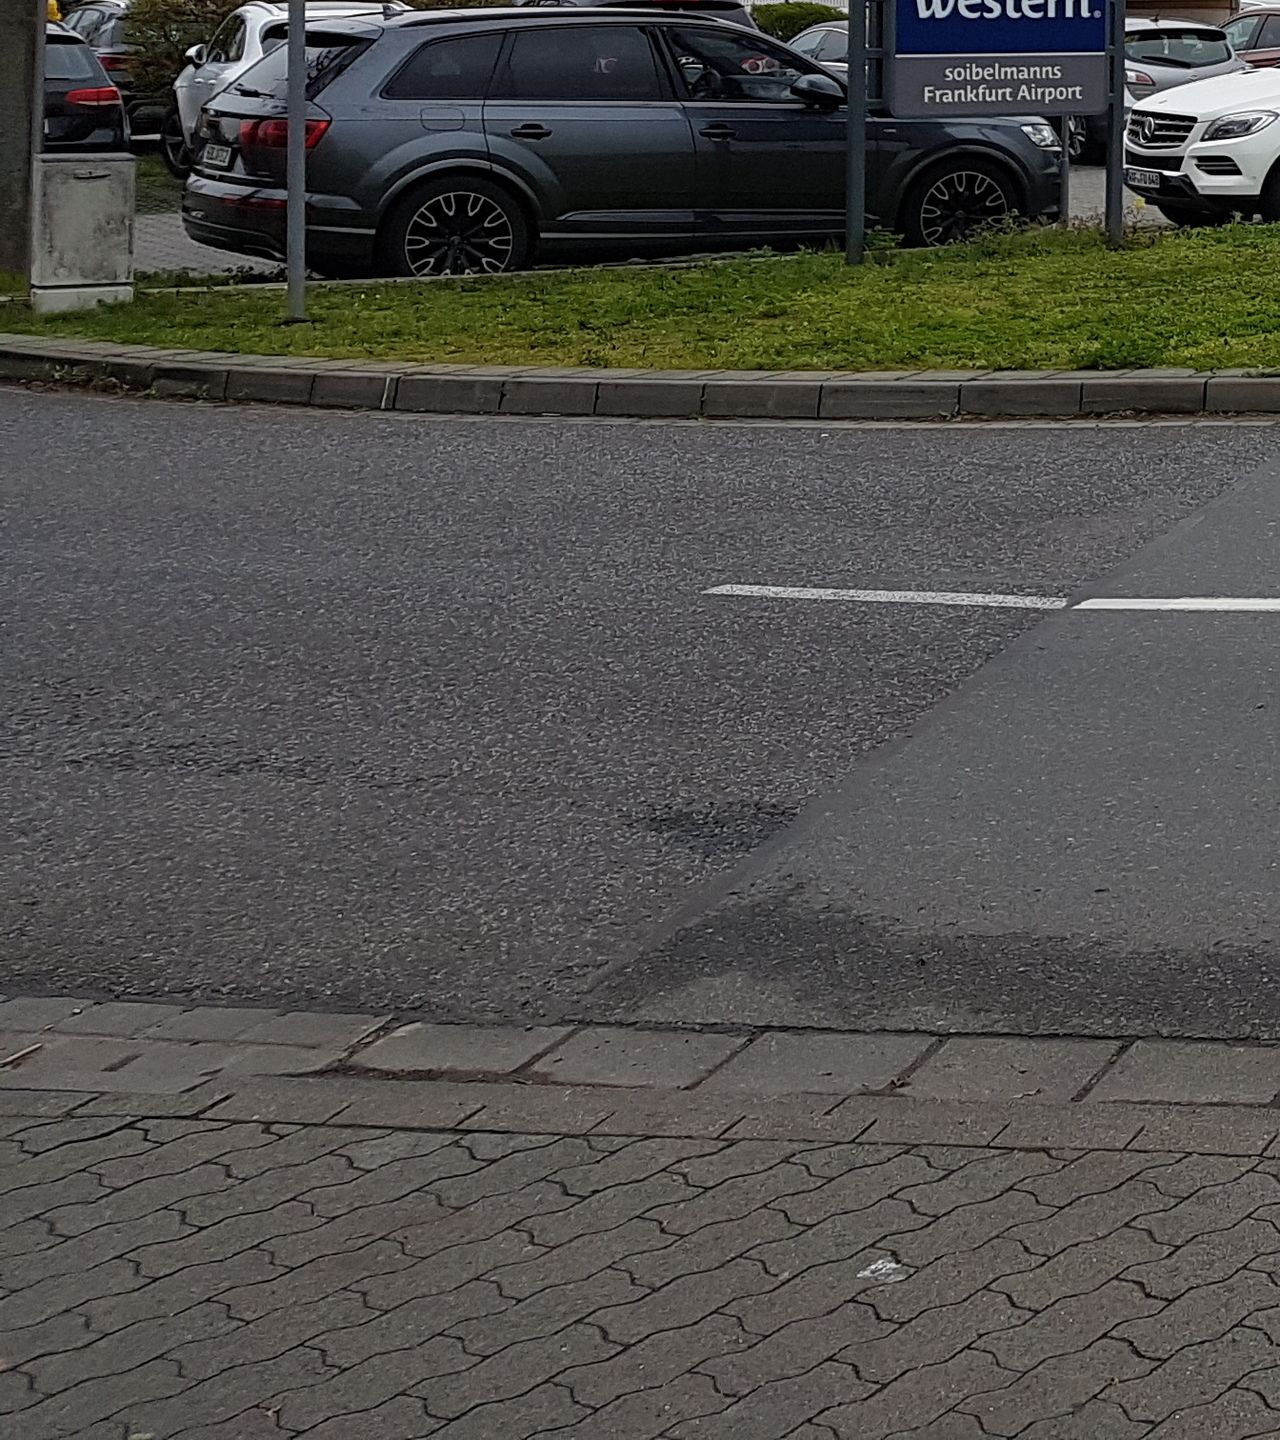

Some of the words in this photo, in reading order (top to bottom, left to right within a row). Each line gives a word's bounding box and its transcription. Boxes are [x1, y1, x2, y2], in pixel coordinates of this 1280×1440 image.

[944, 63, 1062, 81] soibelmanns
[924, 84, 1013, 103] Frankfurt
[1017, 83, 1082, 103] Airport
